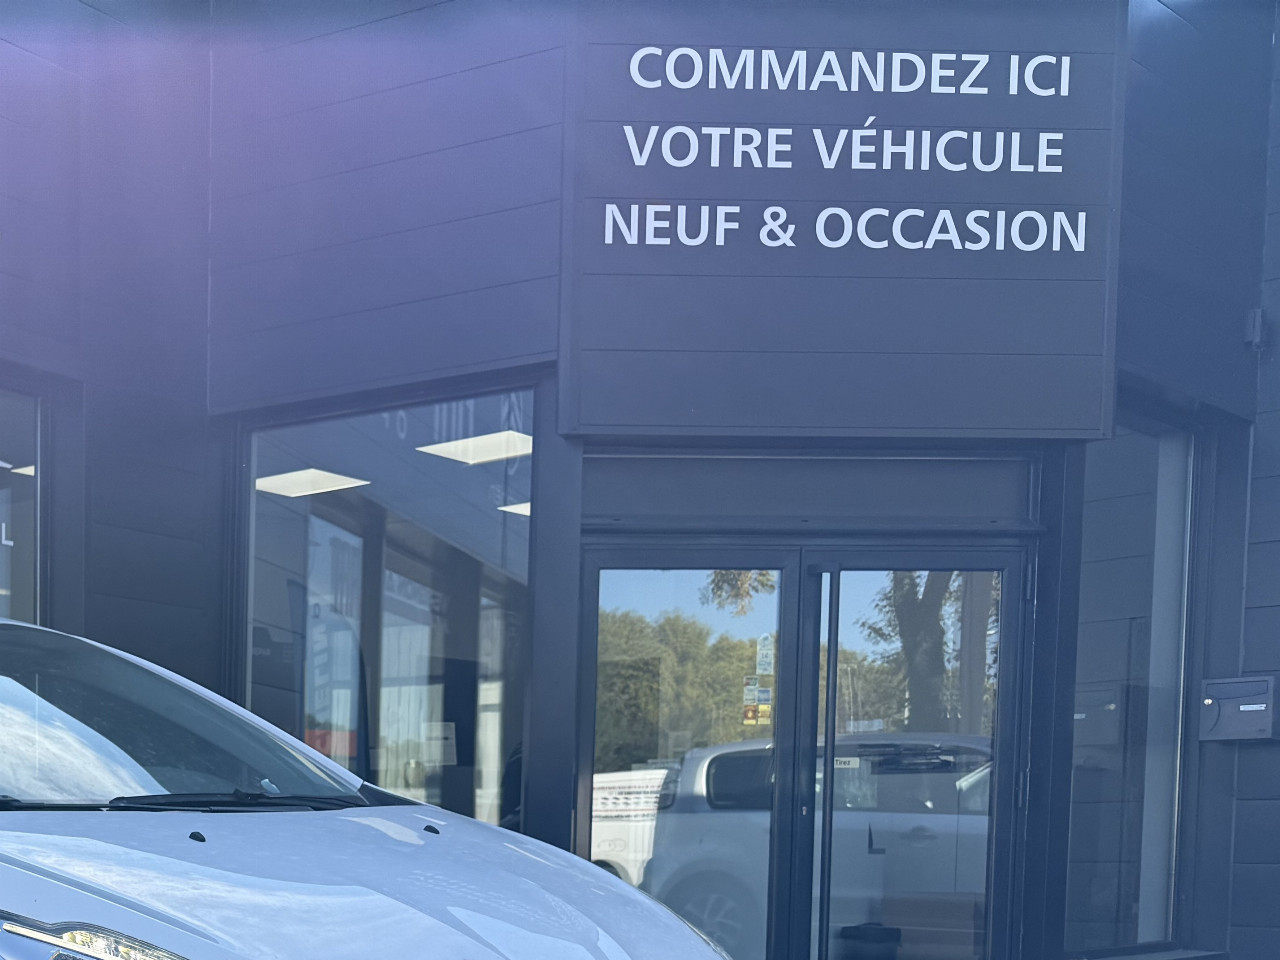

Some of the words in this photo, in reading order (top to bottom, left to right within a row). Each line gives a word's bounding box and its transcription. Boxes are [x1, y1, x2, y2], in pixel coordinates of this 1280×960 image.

[629, 46, 989, 95] COMMANDEZ
[1009, 54, 1071, 97] ICI
[623, 125, 793, 169] VOTRE
[812, 116, 1064, 173] VÉHICULE
[604, 203, 741, 246] NEUF
[758, 206, 797, 247] &
[815, 207, 1087, 252] OCCASION
[835, 758, 851, 766] Tirez
